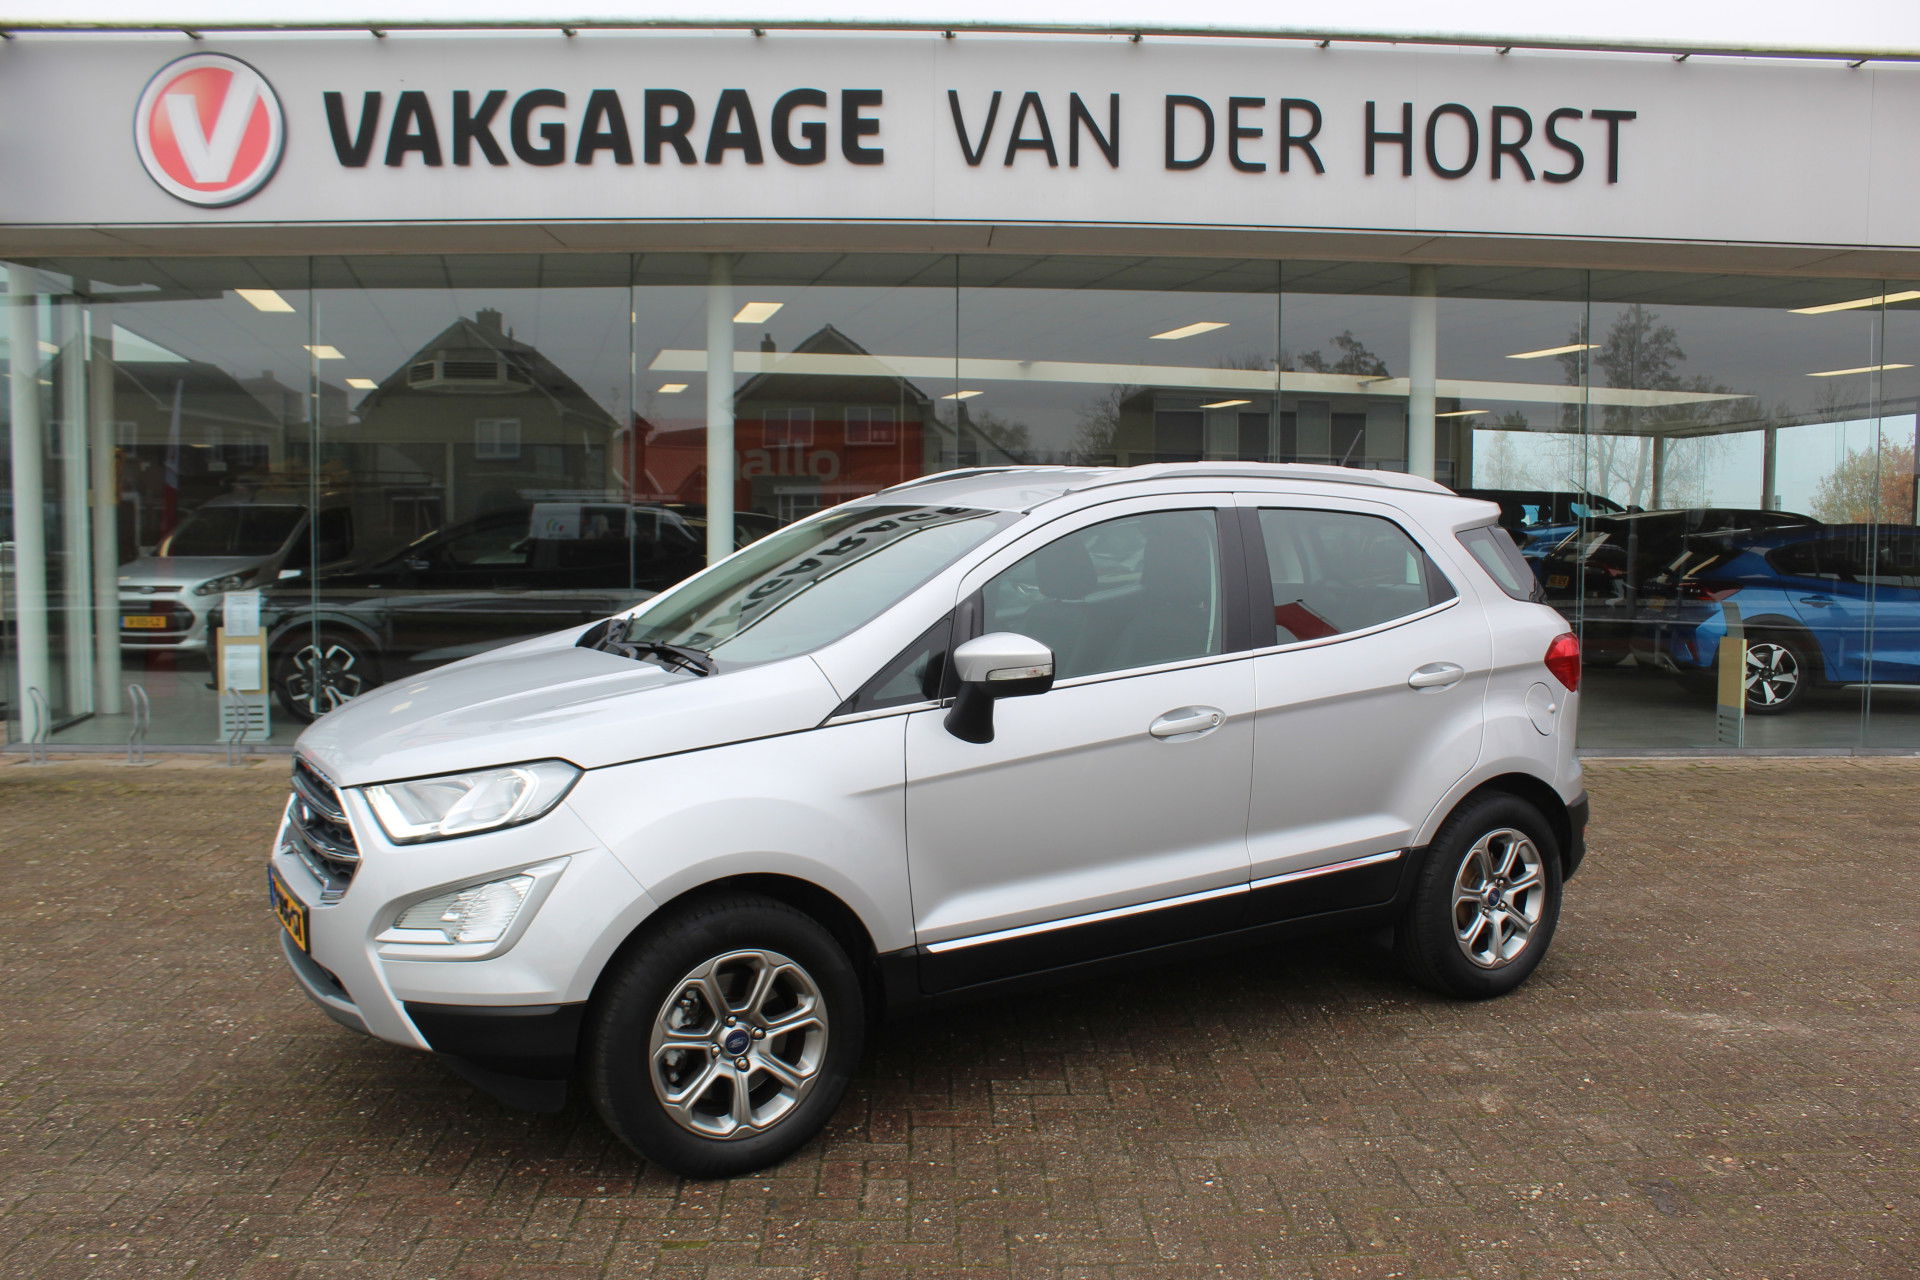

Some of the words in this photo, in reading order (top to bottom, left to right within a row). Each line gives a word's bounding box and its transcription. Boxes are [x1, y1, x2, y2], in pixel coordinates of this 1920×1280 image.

[323, 88, 884, 168] VAKGARAGE
[947, 89, 1120, 169] VAN
[1165, 94, 1326, 175] DER
[1364, 100, 1637, 185] HORST
